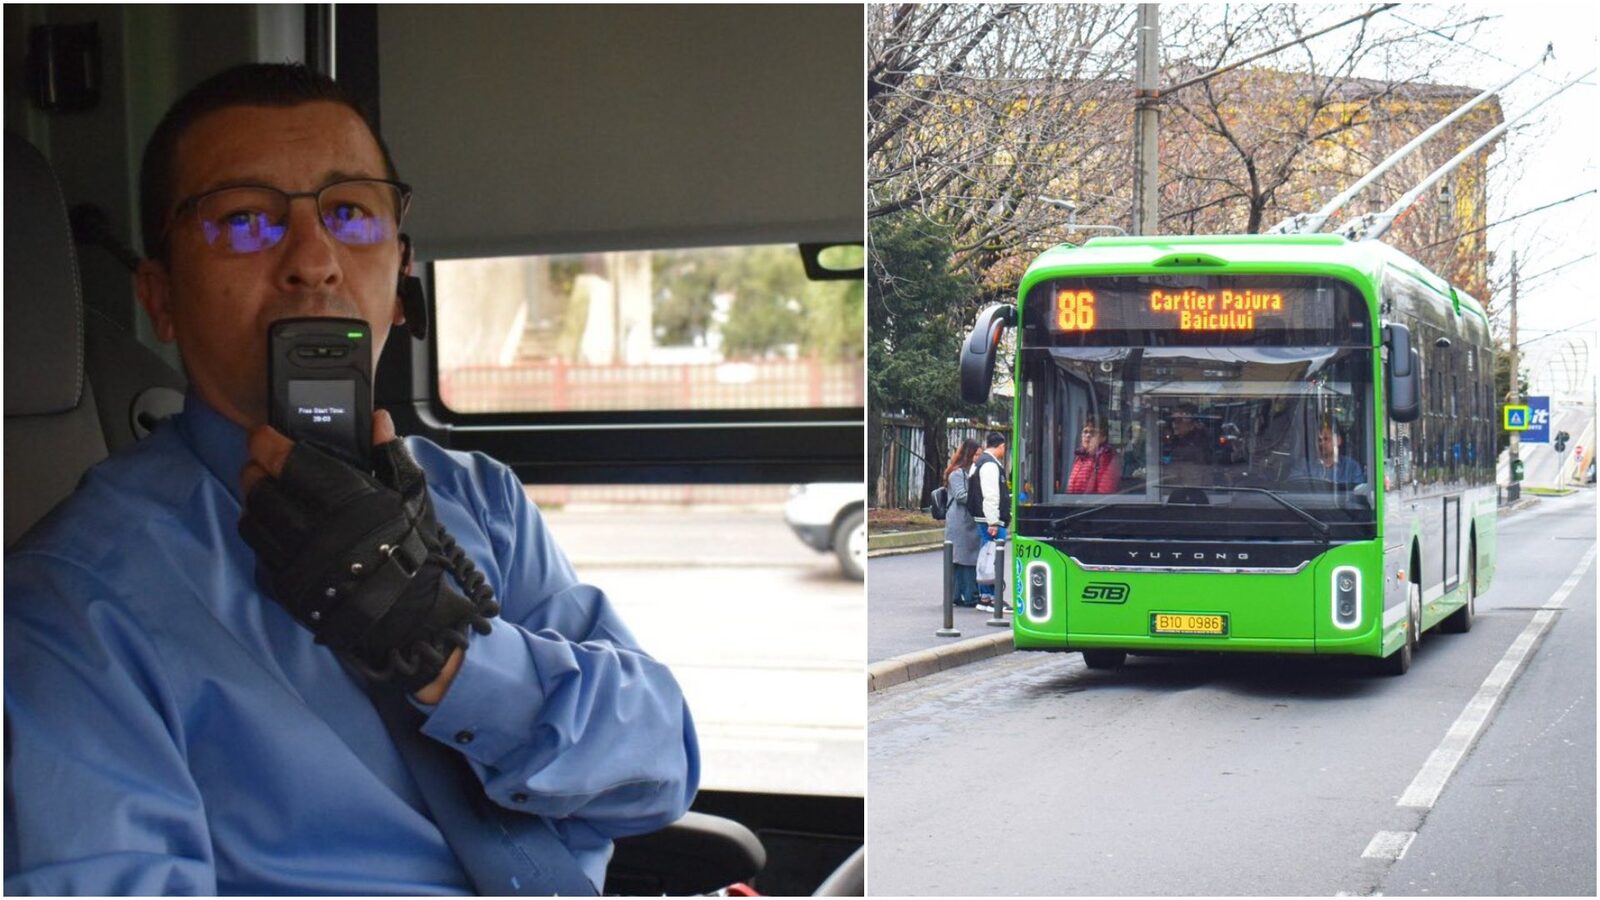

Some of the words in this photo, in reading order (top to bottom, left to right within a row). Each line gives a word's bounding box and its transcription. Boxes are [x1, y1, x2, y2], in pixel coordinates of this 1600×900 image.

[1151, 290, 1217, 311] Cartier
[1221, 291, 1282, 311] Pajura
[1058, 291, 1095, 330] 86
[1180, 310, 1254, 330] Baicului
[1128, 551, 1250, 560] YUTONG
[1081, 585, 1127, 601] STB
[1160, 616, 1182, 629] B10
[1188, 616, 1219, 629] 0986
